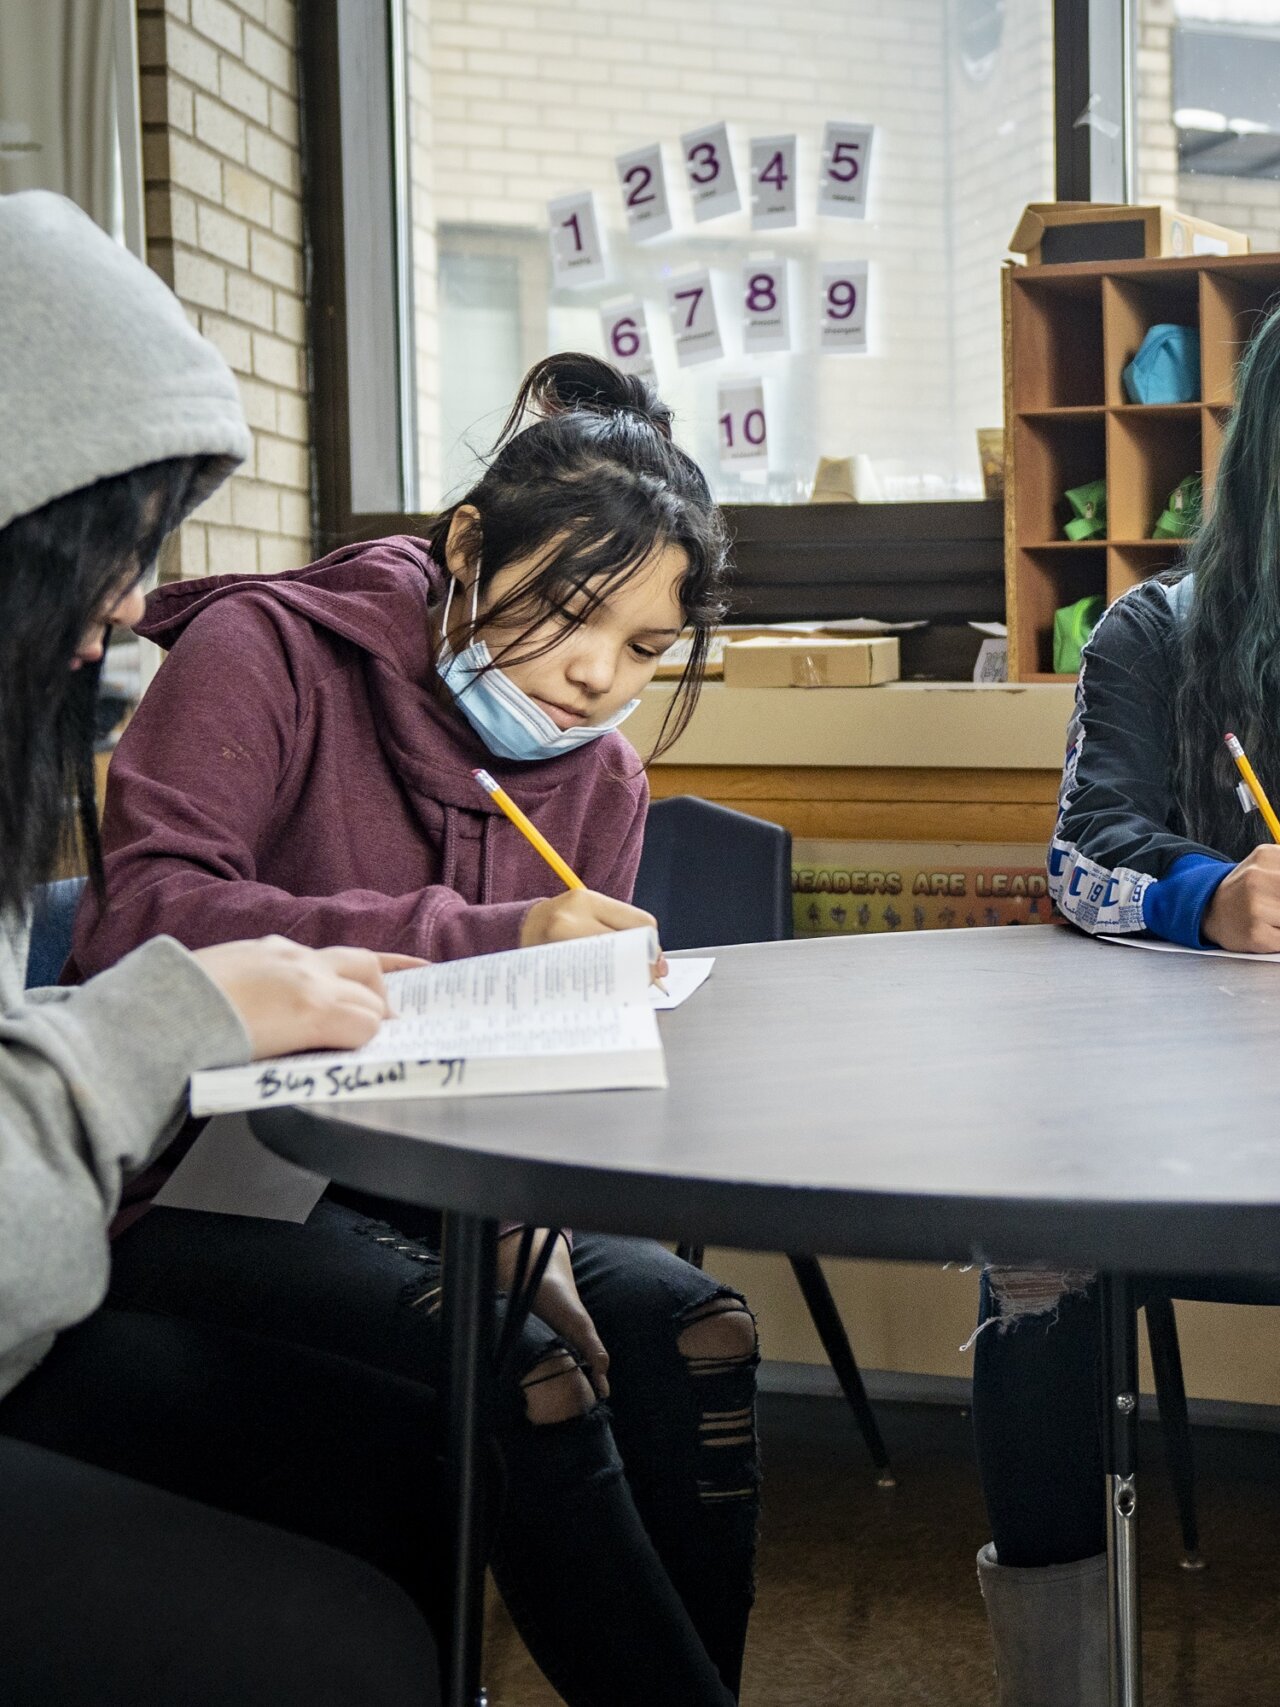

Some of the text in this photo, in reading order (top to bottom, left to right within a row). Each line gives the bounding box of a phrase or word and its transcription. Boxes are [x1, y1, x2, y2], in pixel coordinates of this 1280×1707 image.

[687, 142, 721, 184] 3
[758, 151, 788, 191] 4
[827, 142, 860, 183] 5
[623, 165, 656, 207] 2
[562, 213, 583, 252] 1
[674, 288, 704, 328] 7
[745, 273, 776, 313] 8
[826, 280, 857, 320] 9
[610, 318, 641, 357] 6
[718, 408, 767, 448] 10
[912, 872, 967, 897] ARE
